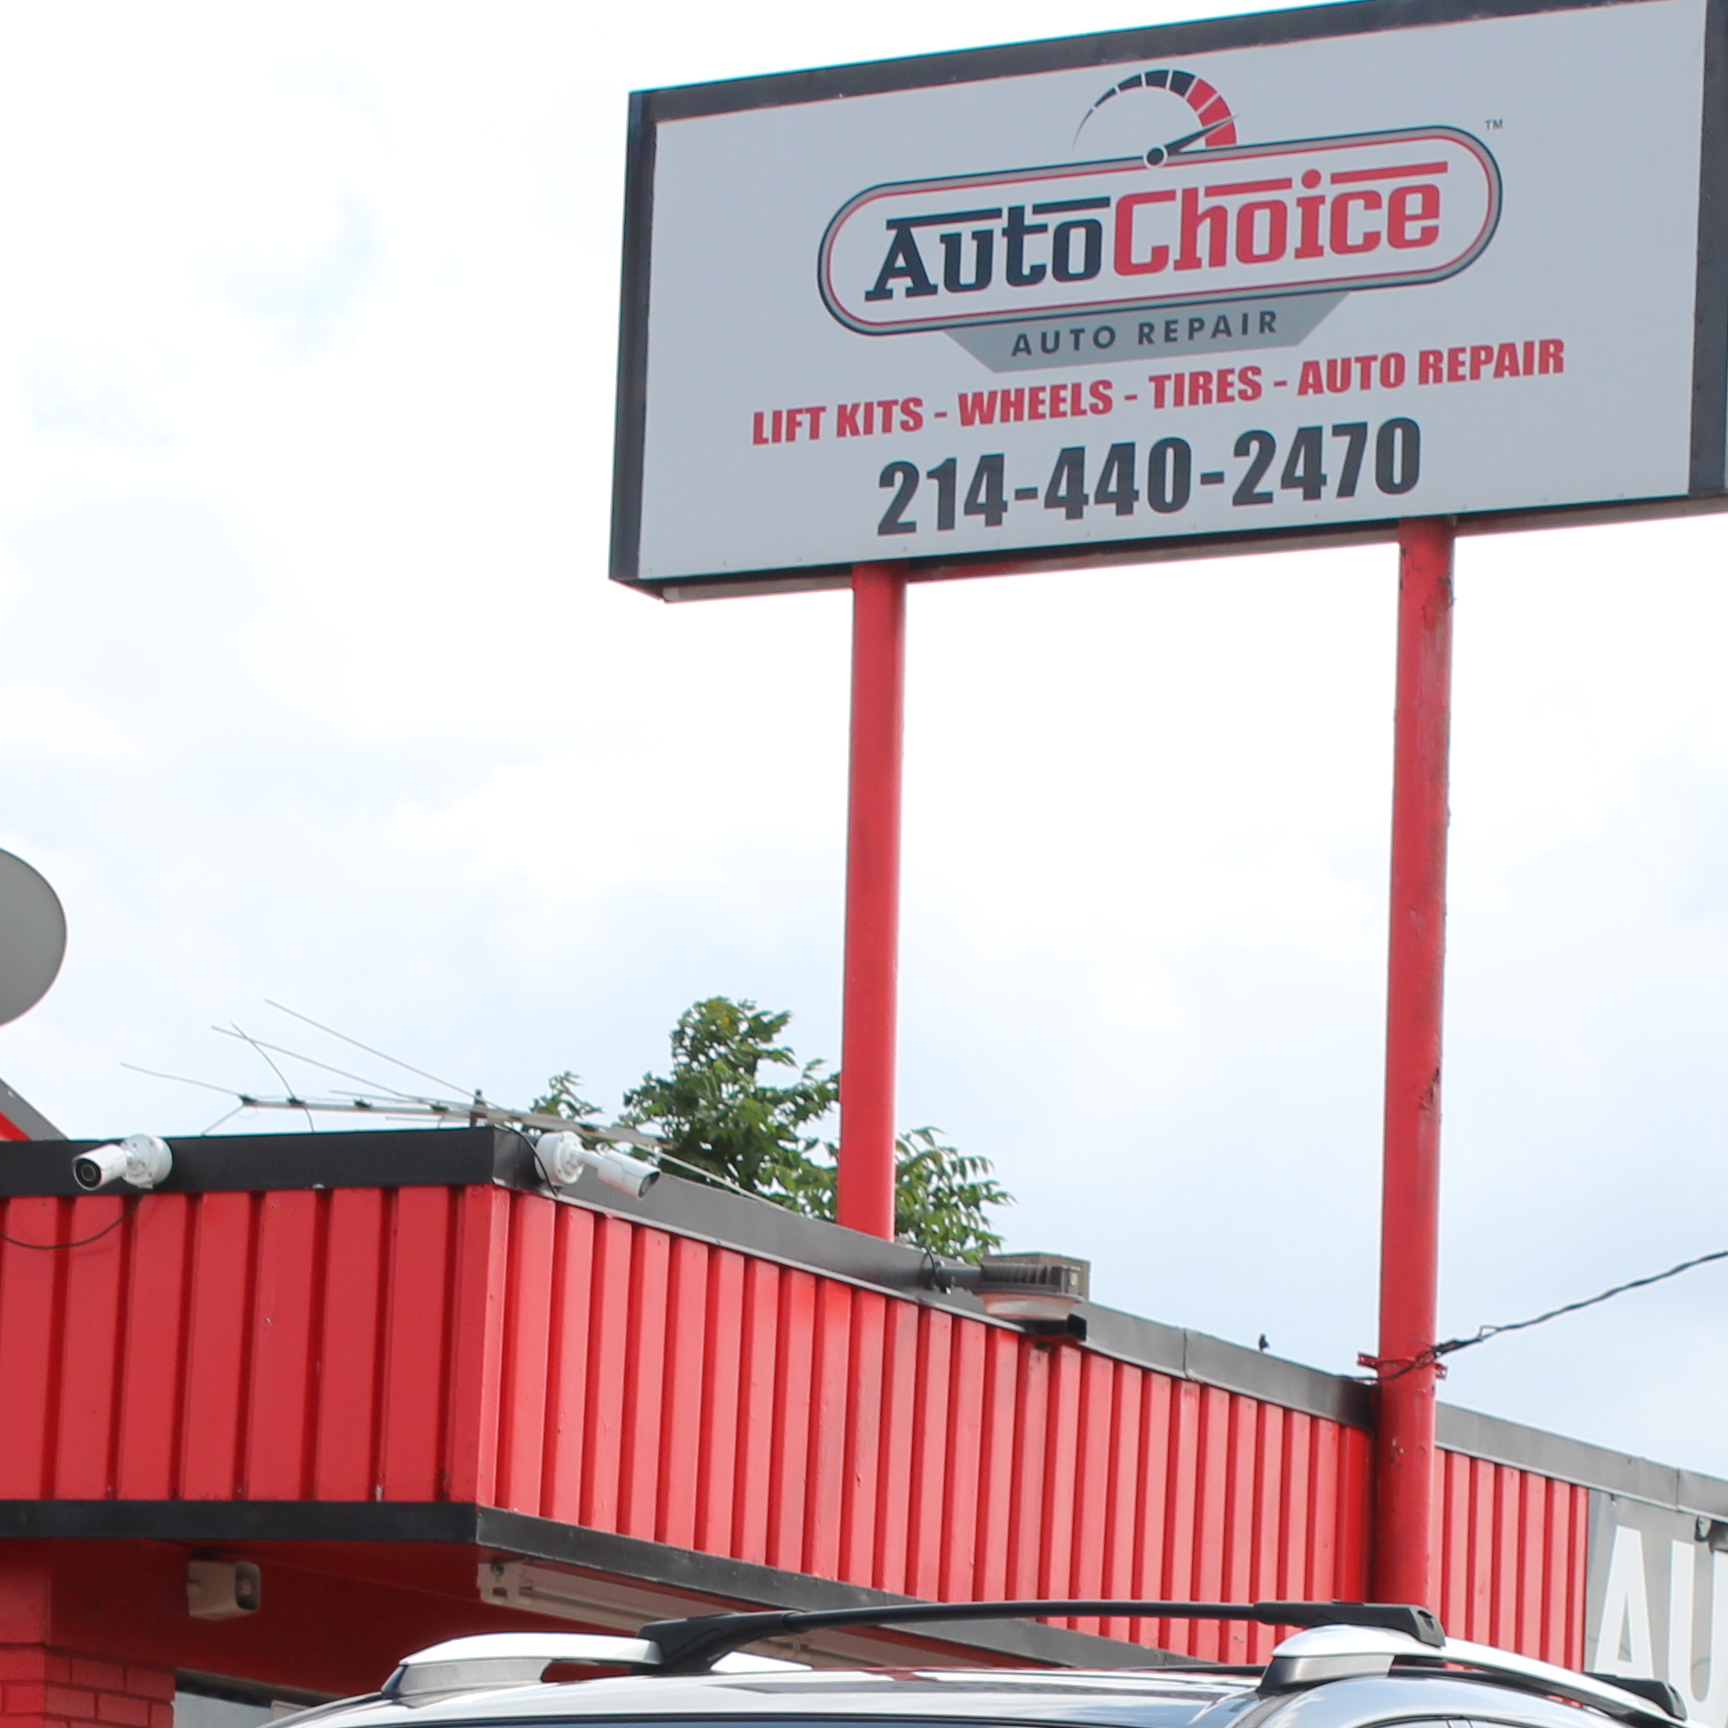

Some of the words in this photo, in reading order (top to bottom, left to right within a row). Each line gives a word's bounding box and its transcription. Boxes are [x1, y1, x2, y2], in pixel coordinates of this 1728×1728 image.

[1011, 325, 1116, 357] AUTO
[1138, 310, 1277, 345] REPAIR
[753, 406, 826, 445] LIFT
[836, 397, 924, 438] KITS
[957, 379, 1113, 427] WHEELS
[1148, 365, 1263, 409] TIRES
[1297, 352, 1406, 396] AUTO
[1418, 338, 1564, 386] REPAIR
[877, 417, 1421, 537] 214-440-2470
